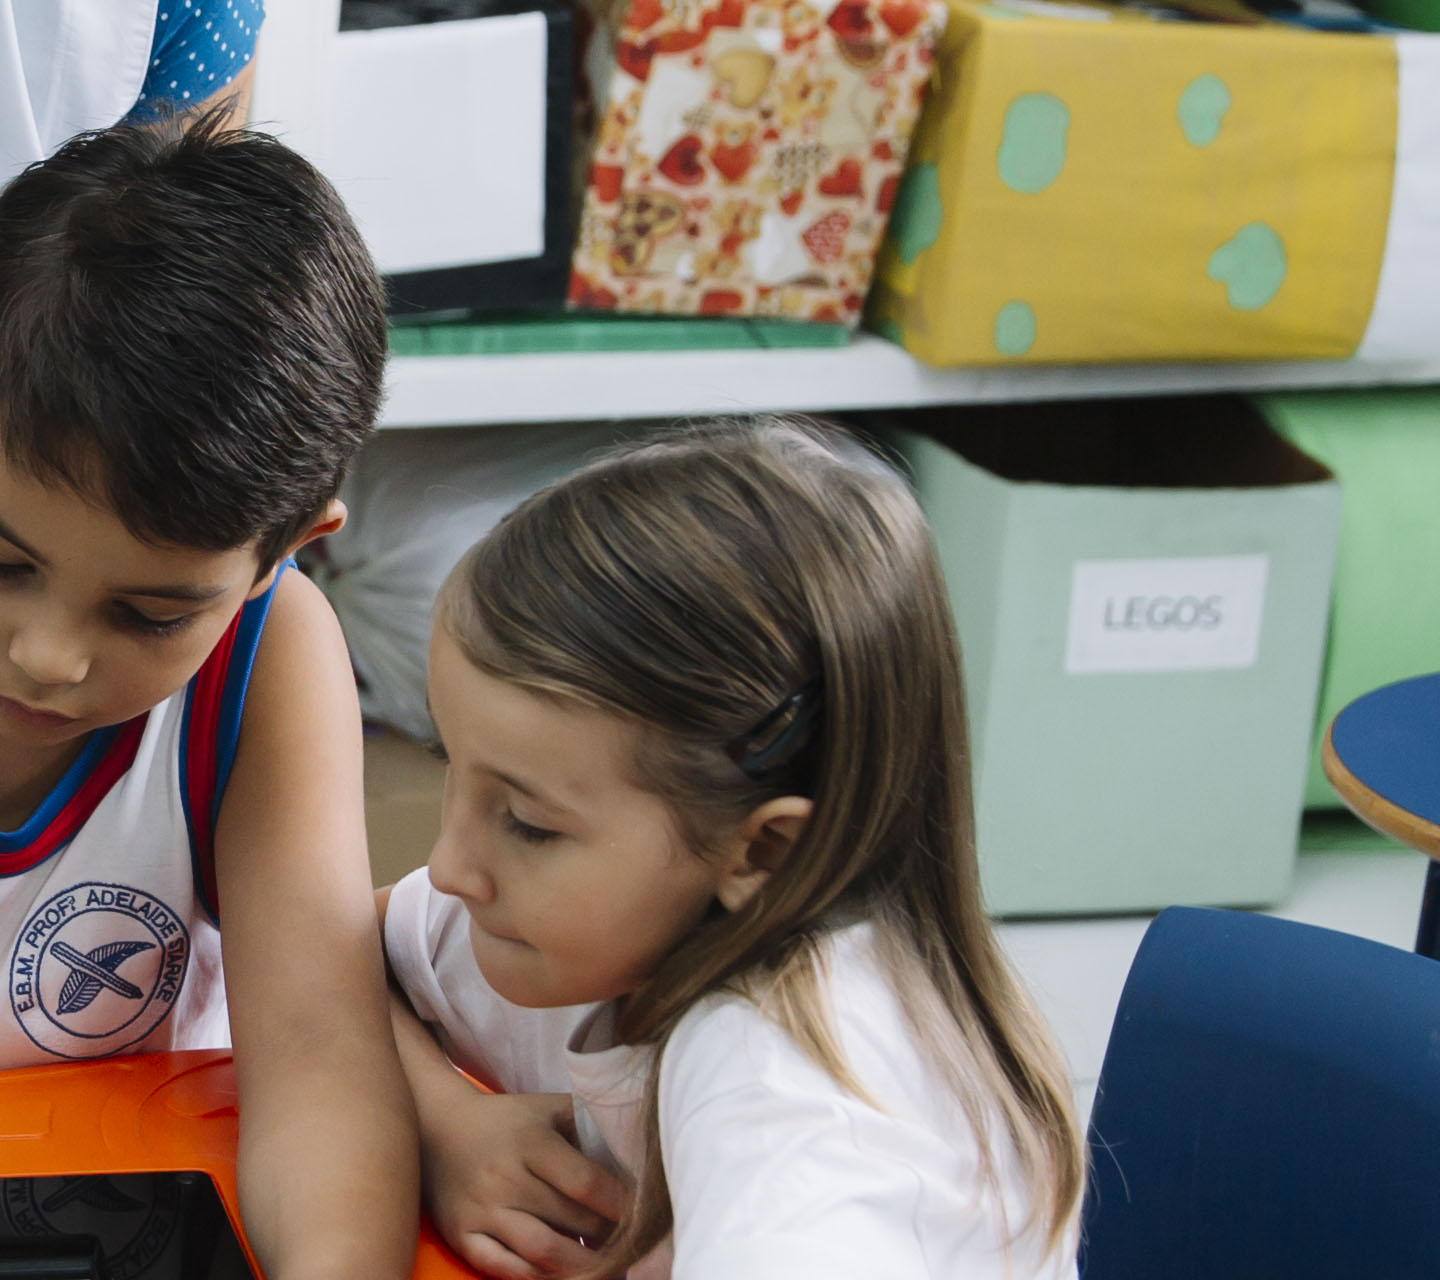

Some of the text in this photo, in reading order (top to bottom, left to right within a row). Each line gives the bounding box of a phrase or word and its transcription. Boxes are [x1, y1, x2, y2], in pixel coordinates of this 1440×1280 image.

[1103, 595, 1224, 631] LEGOS
[86, 888, 179, 940] ADELAIDE
[155, 936, 186, 1004] STARKE
